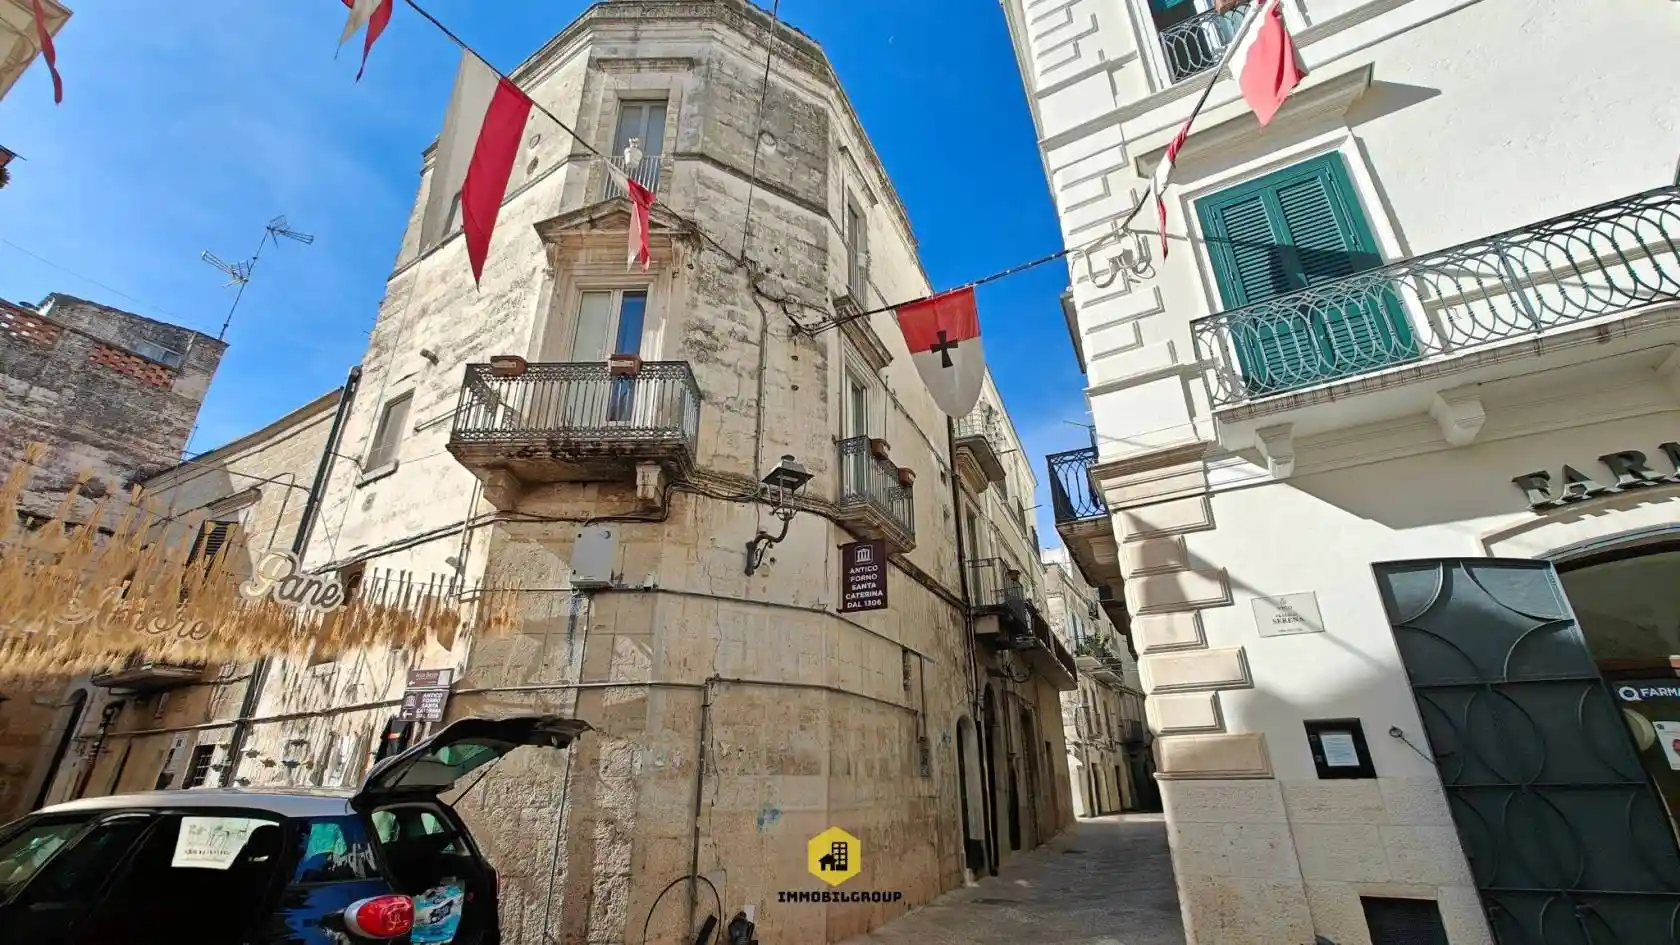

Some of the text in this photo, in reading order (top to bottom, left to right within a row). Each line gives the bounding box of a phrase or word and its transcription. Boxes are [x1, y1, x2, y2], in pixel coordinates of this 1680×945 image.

[850, 565, 878, 574] ANTICO
[242, 550, 342, 609] Pane
[851, 574, 877, 582] FORNO
[851, 582, 876, 590] SANTA
[845, 591, 884, 600] CATERINA
[1272, 616, 1305, 624] SERENA
[1640, 687, 1680, 697] FARM
